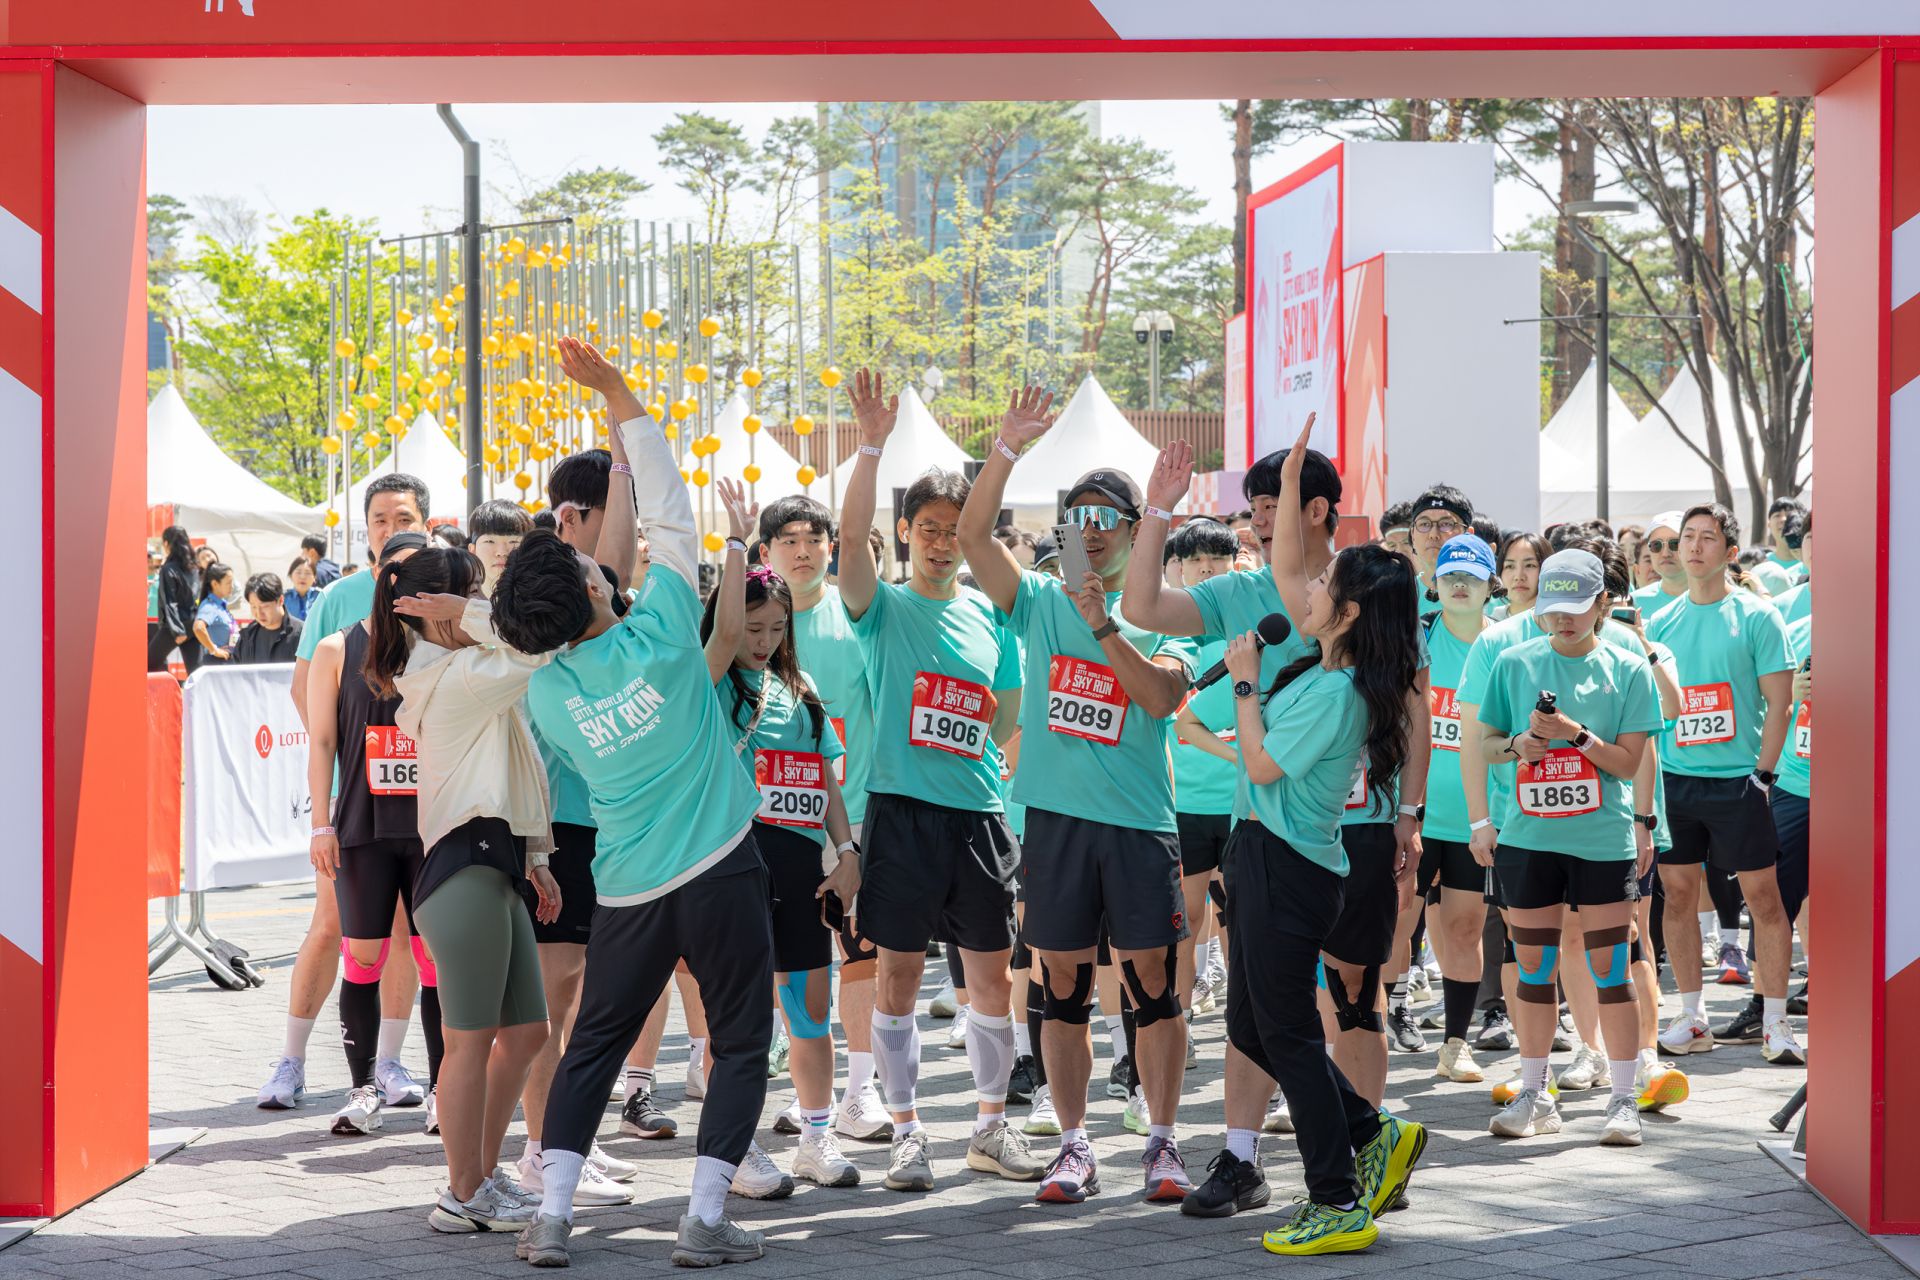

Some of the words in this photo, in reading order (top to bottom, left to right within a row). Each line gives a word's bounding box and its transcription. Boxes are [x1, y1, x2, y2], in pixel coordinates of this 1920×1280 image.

[1283, 304, 1298, 368] SKY
[1301, 297, 1318, 362] RUN
[1544, 580, 1579, 592] HOKA
[1072, 674, 1092, 690] SKY
[1093, 678, 1113, 696] RUN
[565, 696, 584, 711] 2025
[571, 706, 594, 722] LOTTE
[594, 692, 624, 712] WORLD
[623, 676, 646, 698] TOWER
[944, 692, 963, 706] SKY
[963, 696, 982, 713] RUN
[1689, 697, 1702, 708] SKY
[1704, 696, 1718, 706] RUN
[578, 710, 622, 748] SKY
[618, 684, 665, 729] RUN
[1049, 697, 1113, 730] 2089
[920, 713, 980, 747] 1906
[1432, 721, 1462, 741] 19
[1680, 716, 1726, 736] 1732
[396, 740, 412, 752] SKY
[595, 744, 617, 759] WITH
[620, 715, 661, 748] SPYDER
[784, 767, 801, 780] SKY
[803, 768, 819, 781] RUN
[1545, 763, 1562, 775] SKY
[1564, 761, 1582, 774] RUN
[770, 791, 824, 816] 2090
[1530, 785, 1590, 807] 1863
